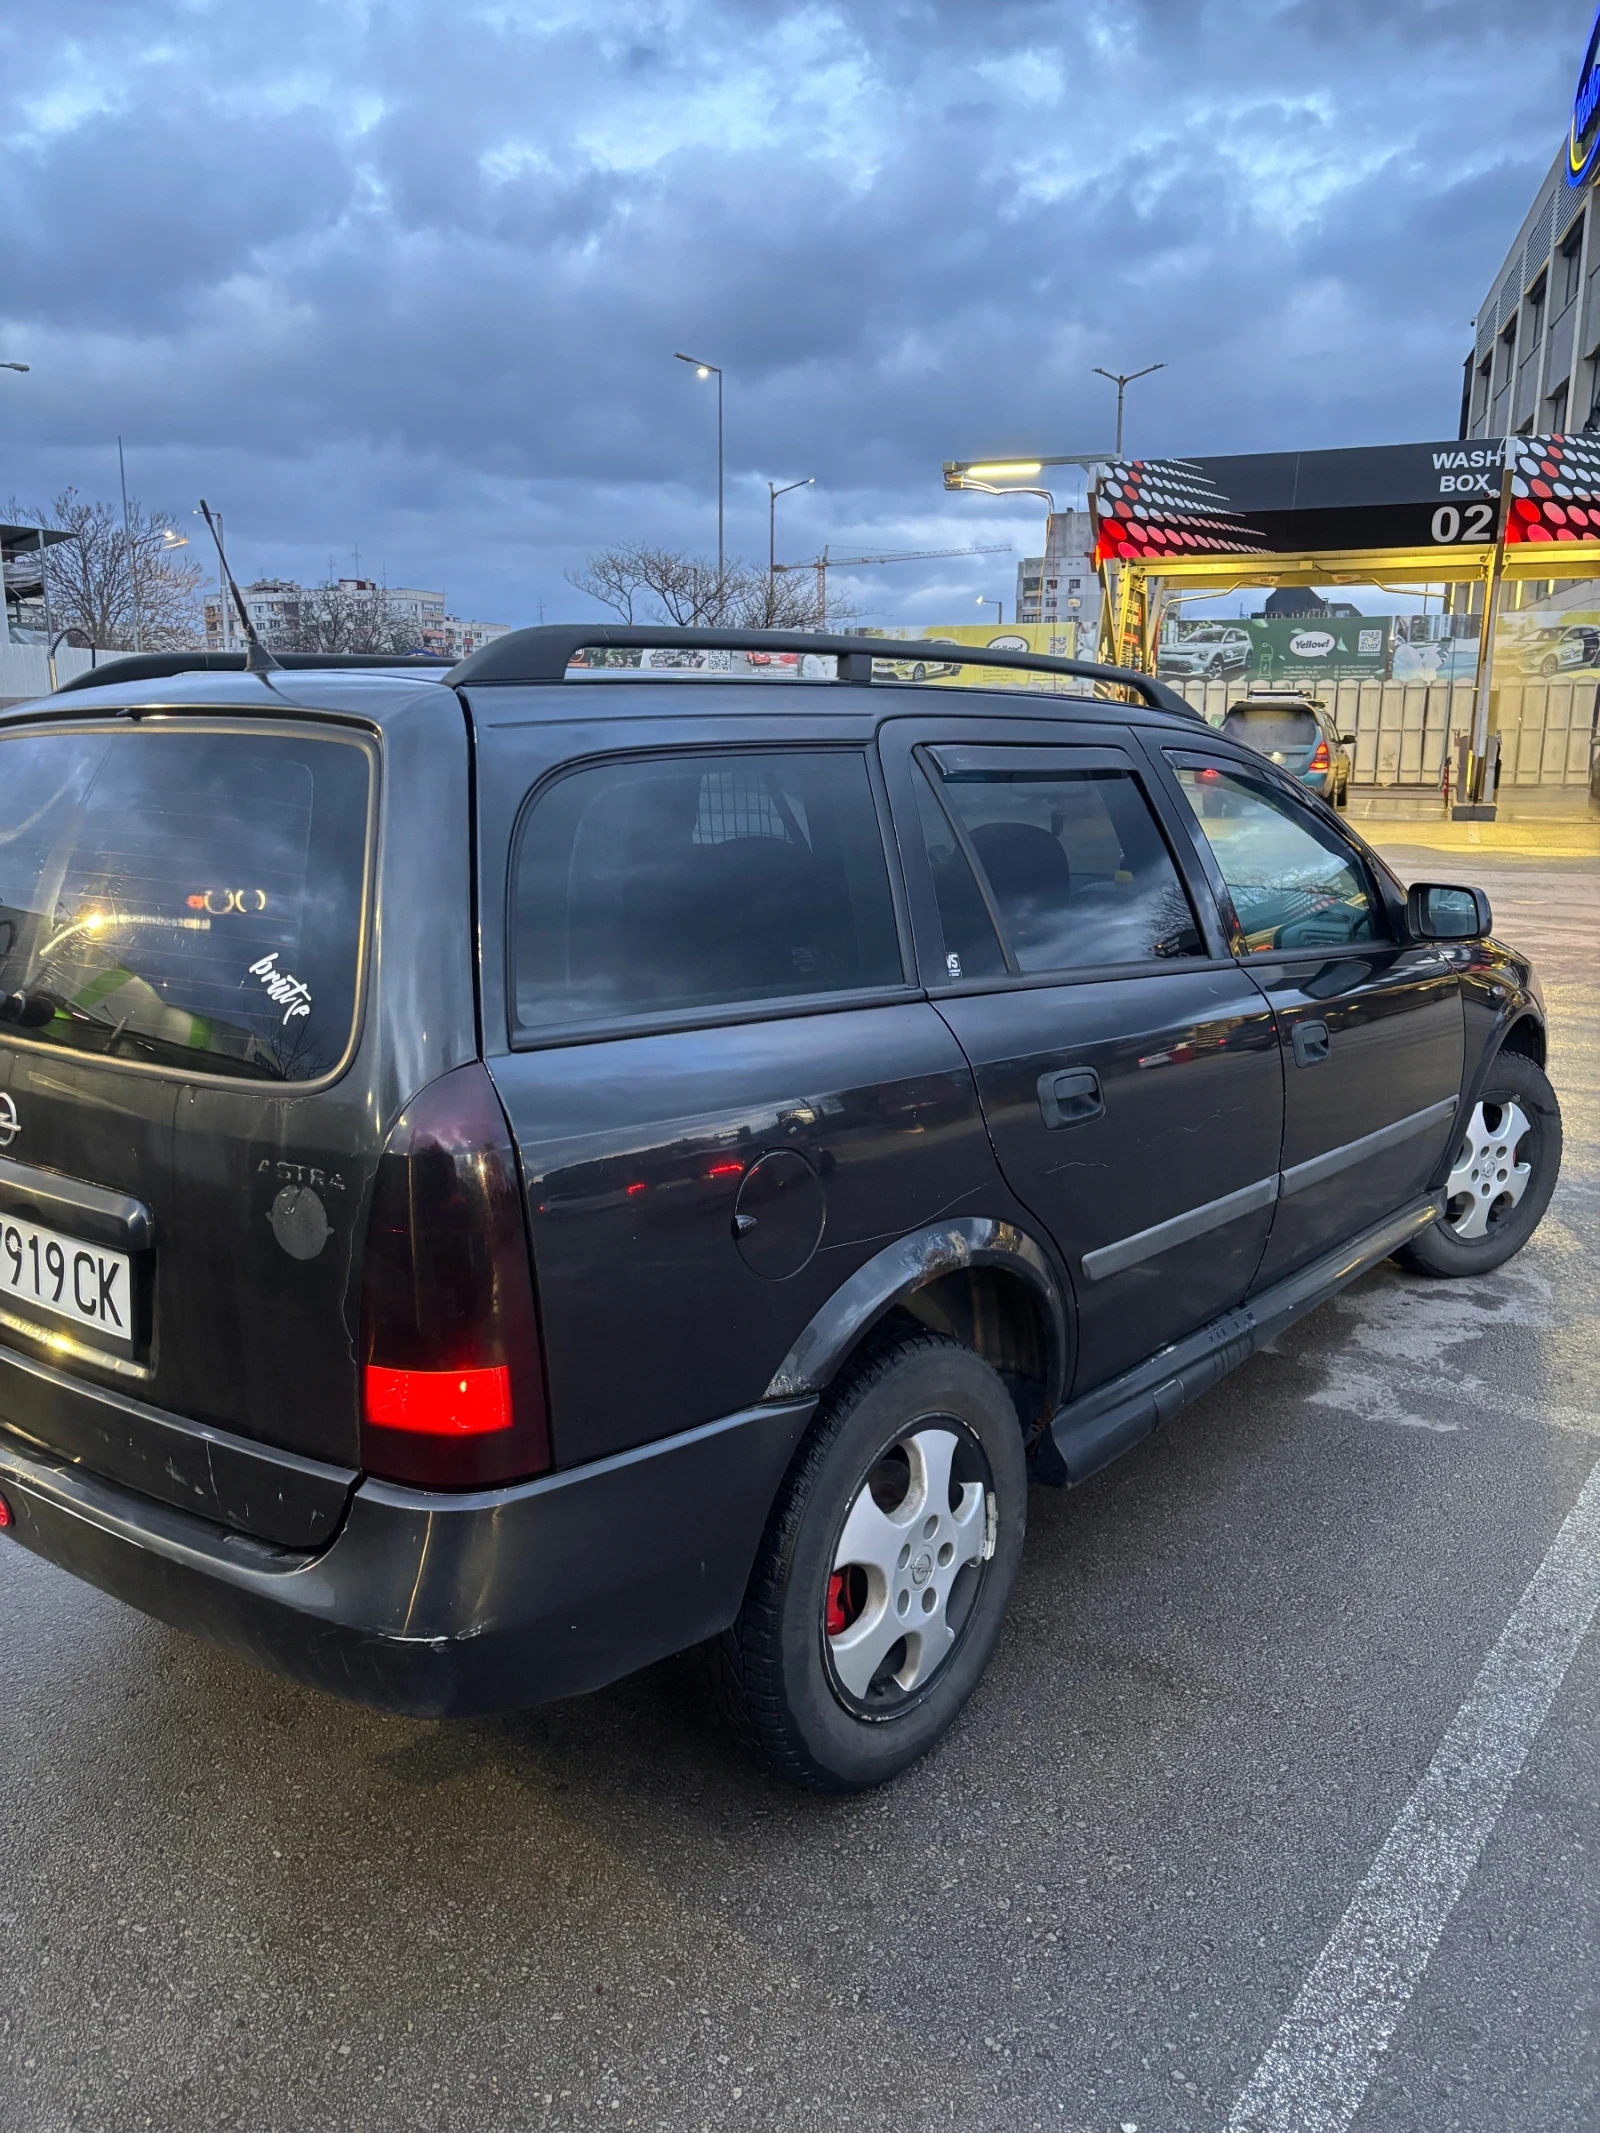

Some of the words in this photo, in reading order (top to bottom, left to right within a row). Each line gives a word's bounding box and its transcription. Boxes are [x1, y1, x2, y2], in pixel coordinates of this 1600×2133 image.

[1432, 450, 1500, 470] WASH
[1439, 473, 1491, 493] BOX
[1431, 504, 1494, 543] 02
[1295, 639, 1331, 649] Yellow!
